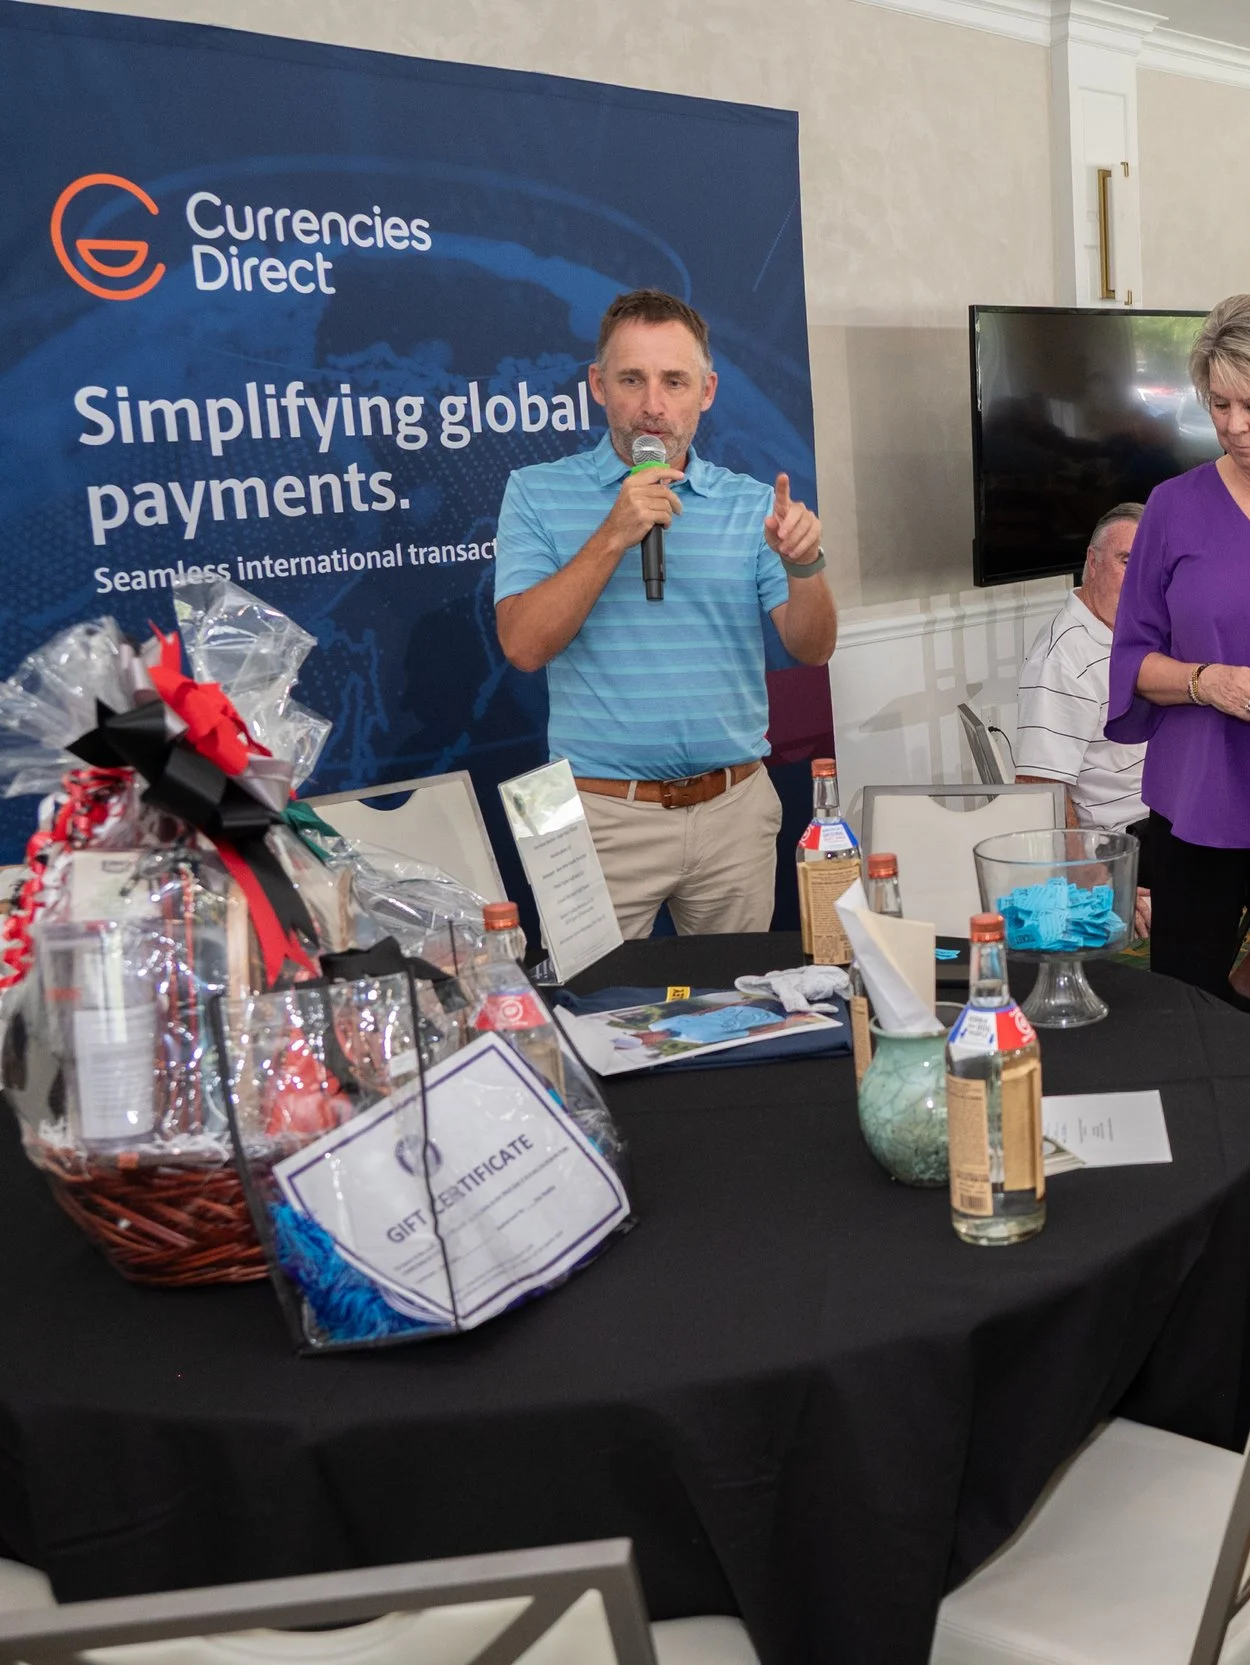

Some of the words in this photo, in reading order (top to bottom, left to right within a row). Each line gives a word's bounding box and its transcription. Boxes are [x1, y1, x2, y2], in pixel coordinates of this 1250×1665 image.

[186, 191, 432, 252] Currencies
[192, 246, 336, 296] Direct
[74, 381, 427, 455] Simplifying
[439, 381, 591, 450] global
[88, 463, 412, 546] payments.
[94, 560, 231, 594] Seamless
[237, 544, 404, 583] international
[386, 1209, 427, 1243] GIFT
